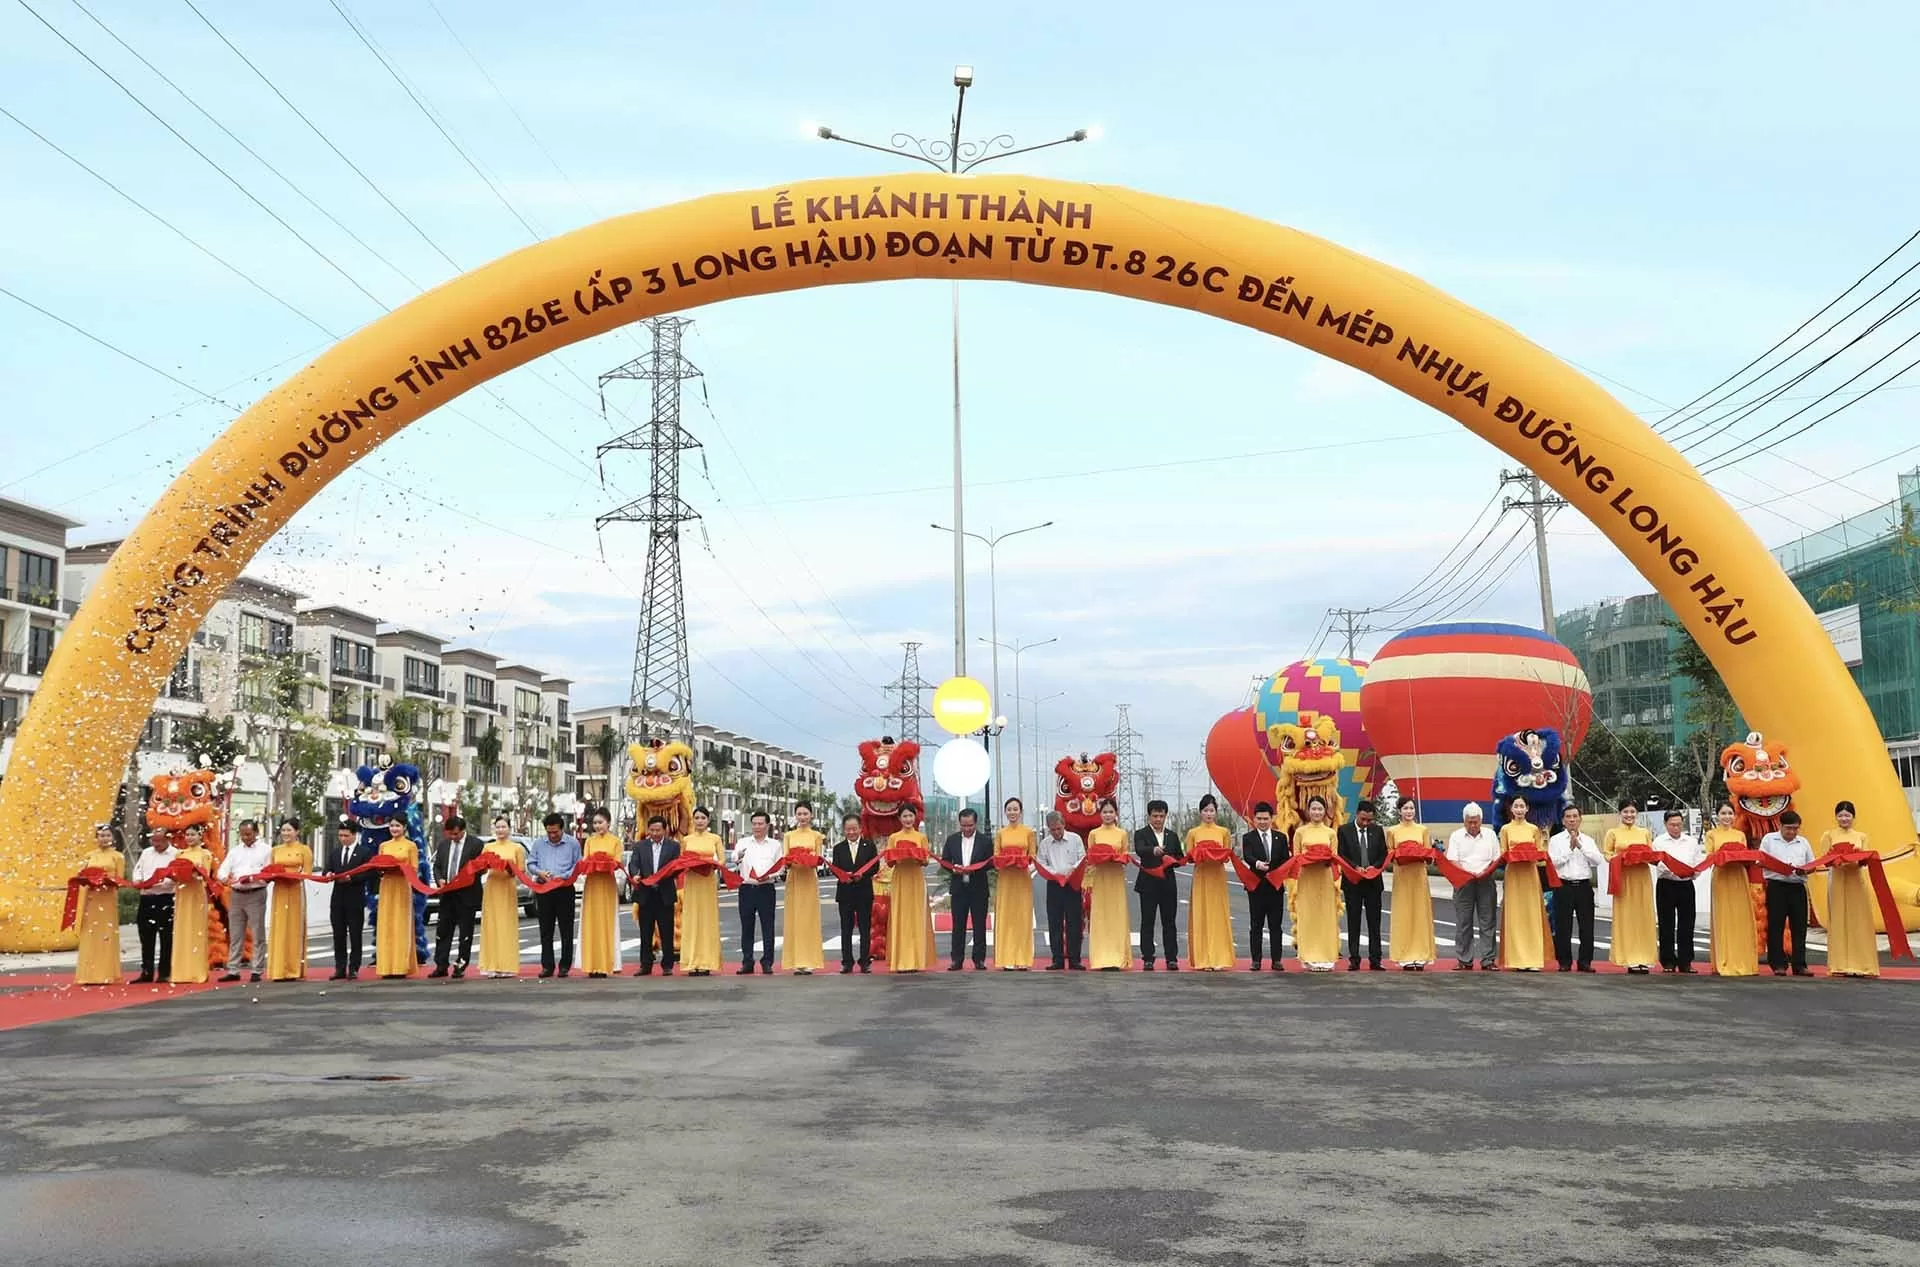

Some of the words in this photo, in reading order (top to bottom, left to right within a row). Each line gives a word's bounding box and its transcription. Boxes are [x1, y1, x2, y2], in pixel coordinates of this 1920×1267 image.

[751, 190, 796, 231] LỄ
[806, 185, 949, 224] KHÁNH
[956, 189, 1093, 230] THÀNH
[192, 472, 287, 560] TRÌNH
[278, 386, 400, 478] ĐƯỜNG
[395, 338, 482, 396] TỈNH
[483, 298, 571, 352] 826E
[573, 268, 632, 317] (ẤP
[642, 267, 667, 296] 3
[672, 246, 778, 289] LONG
[786, 228, 877, 269] HẬU)
[885, 231, 993, 265] ĐOẠN
[1005, 227, 1056, 264] TỪ
[1237, 275, 1314, 321] ĐẾN
[1316, 309, 1394, 349] MÉP
[1396, 337, 1490, 409] NHỰA
[1494, 396, 1615, 495] ĐƯỜNG
[1609, 488, 1700, 577] LONG
[1690, 574, 1758, 646] HẬU
